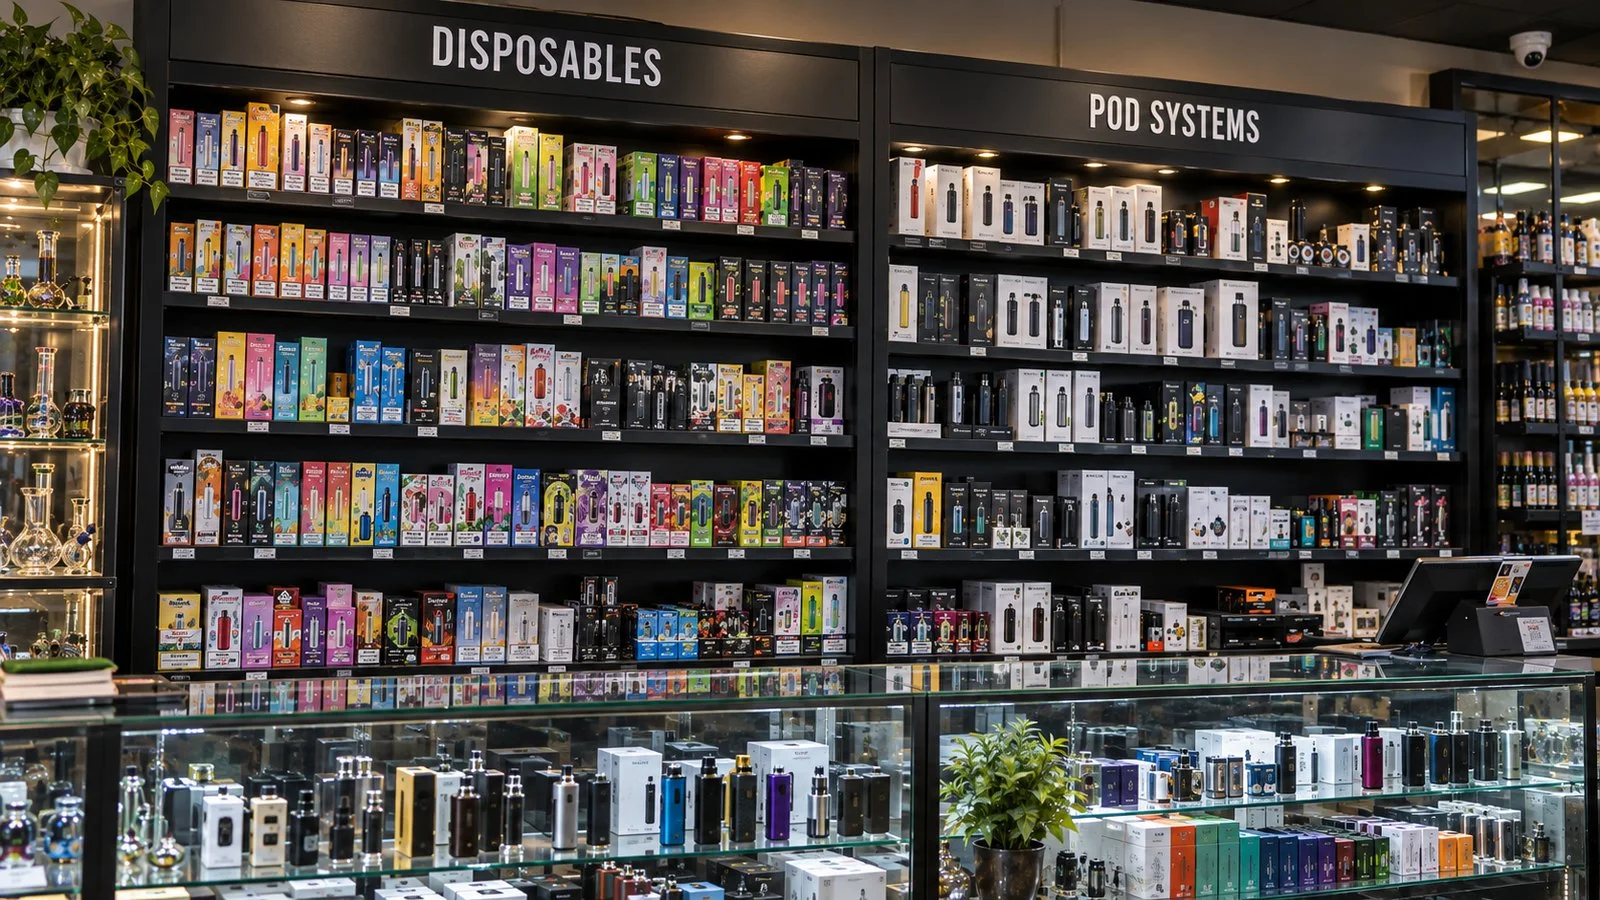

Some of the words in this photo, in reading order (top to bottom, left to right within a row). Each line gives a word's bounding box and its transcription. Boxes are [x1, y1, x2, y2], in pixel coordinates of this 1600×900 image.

[433, 25, 662, 87] DISPOSABLES
[1089, 93, 1140, 132] POD
[1150, 100, 1260, 143] SYSTEMS
